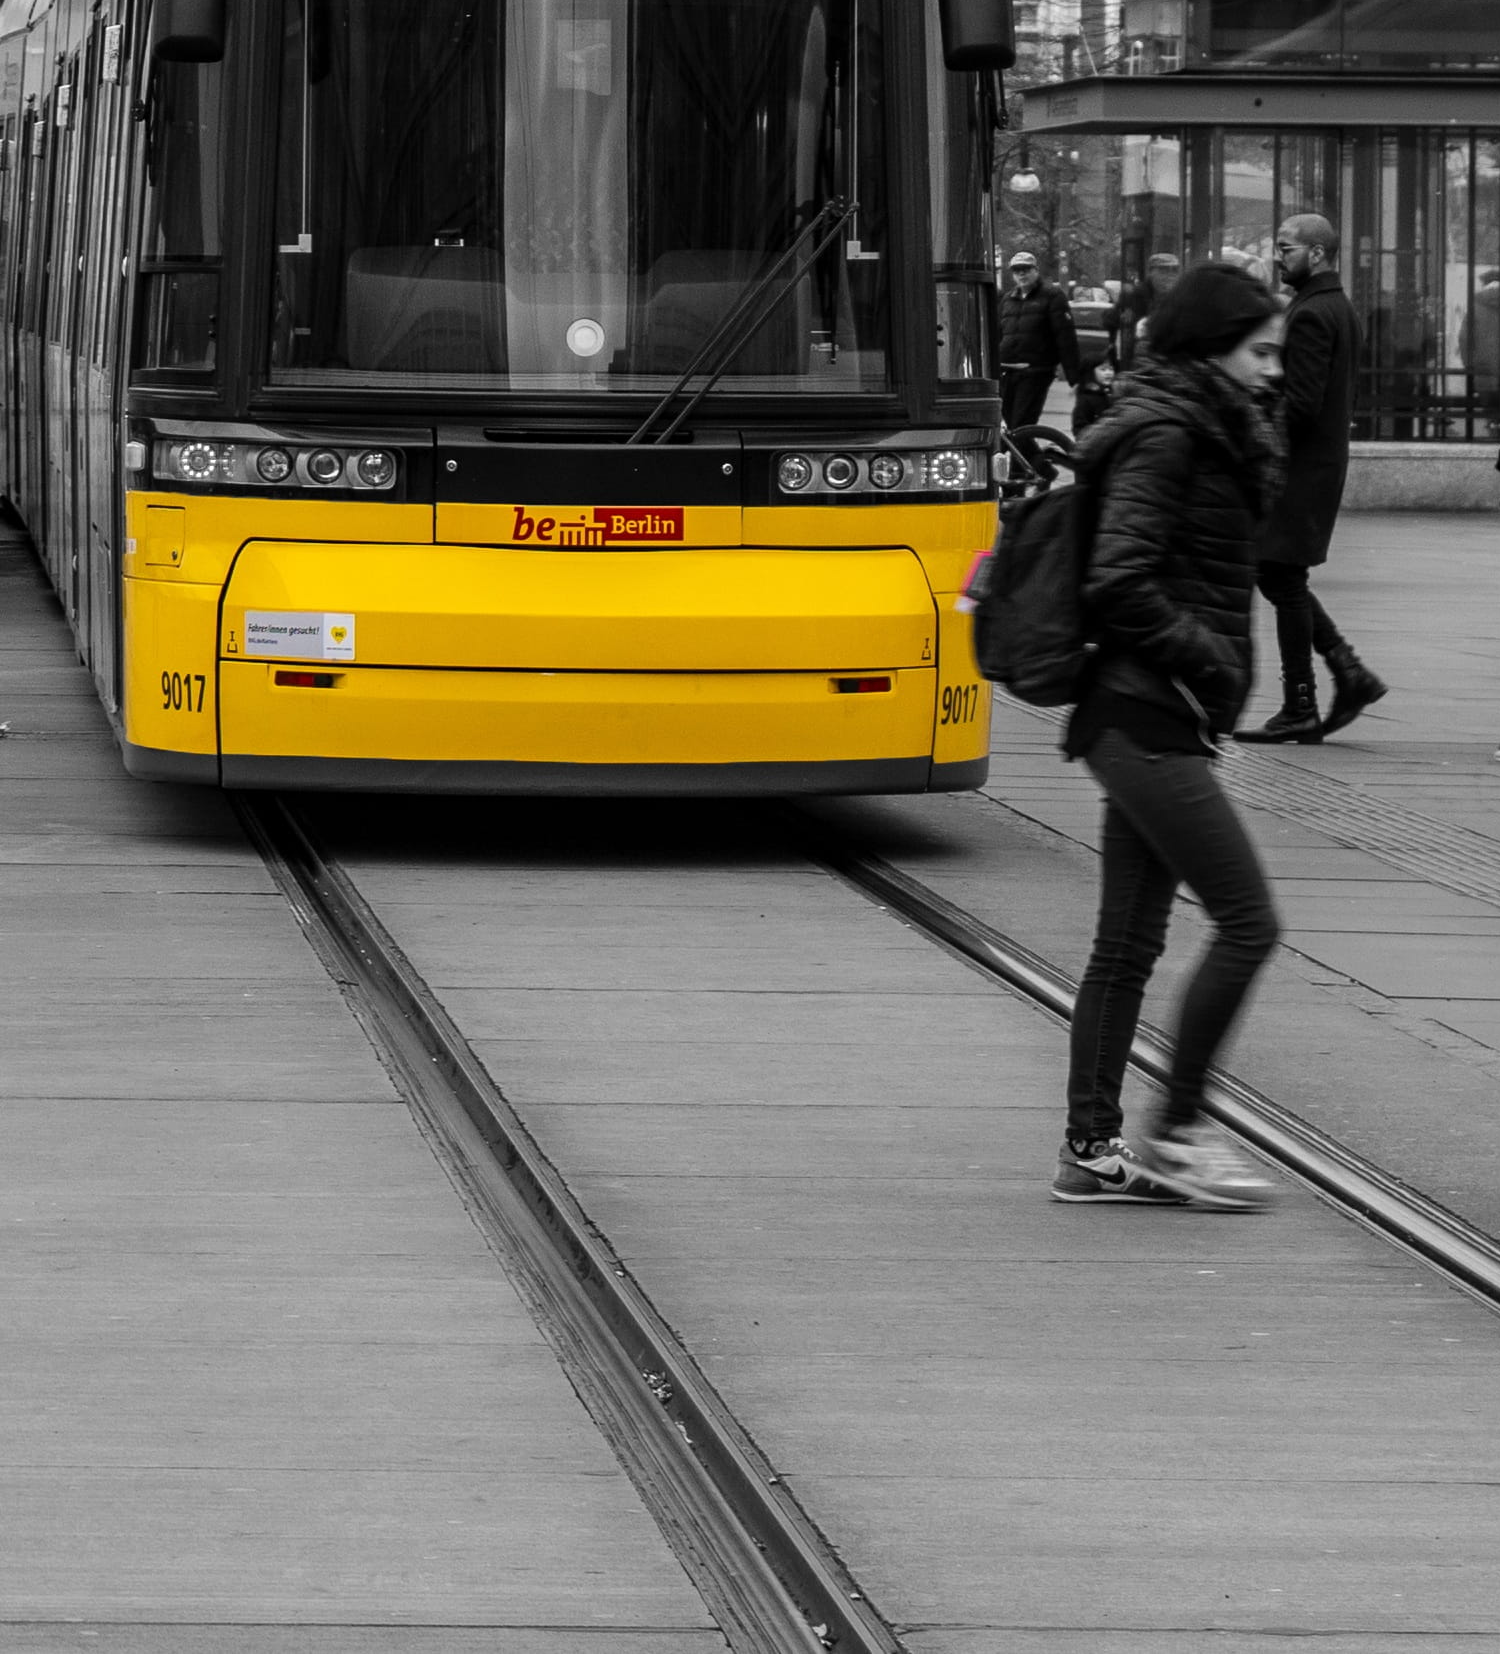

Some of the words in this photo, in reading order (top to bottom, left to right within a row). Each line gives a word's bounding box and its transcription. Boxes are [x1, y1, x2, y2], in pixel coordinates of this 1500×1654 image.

[512, 506, 556, 541] be
[611, 514, 675, 534] Berlin
[162, 671, 206, 713] 9017
[941, 683, 978, 725] 9017
